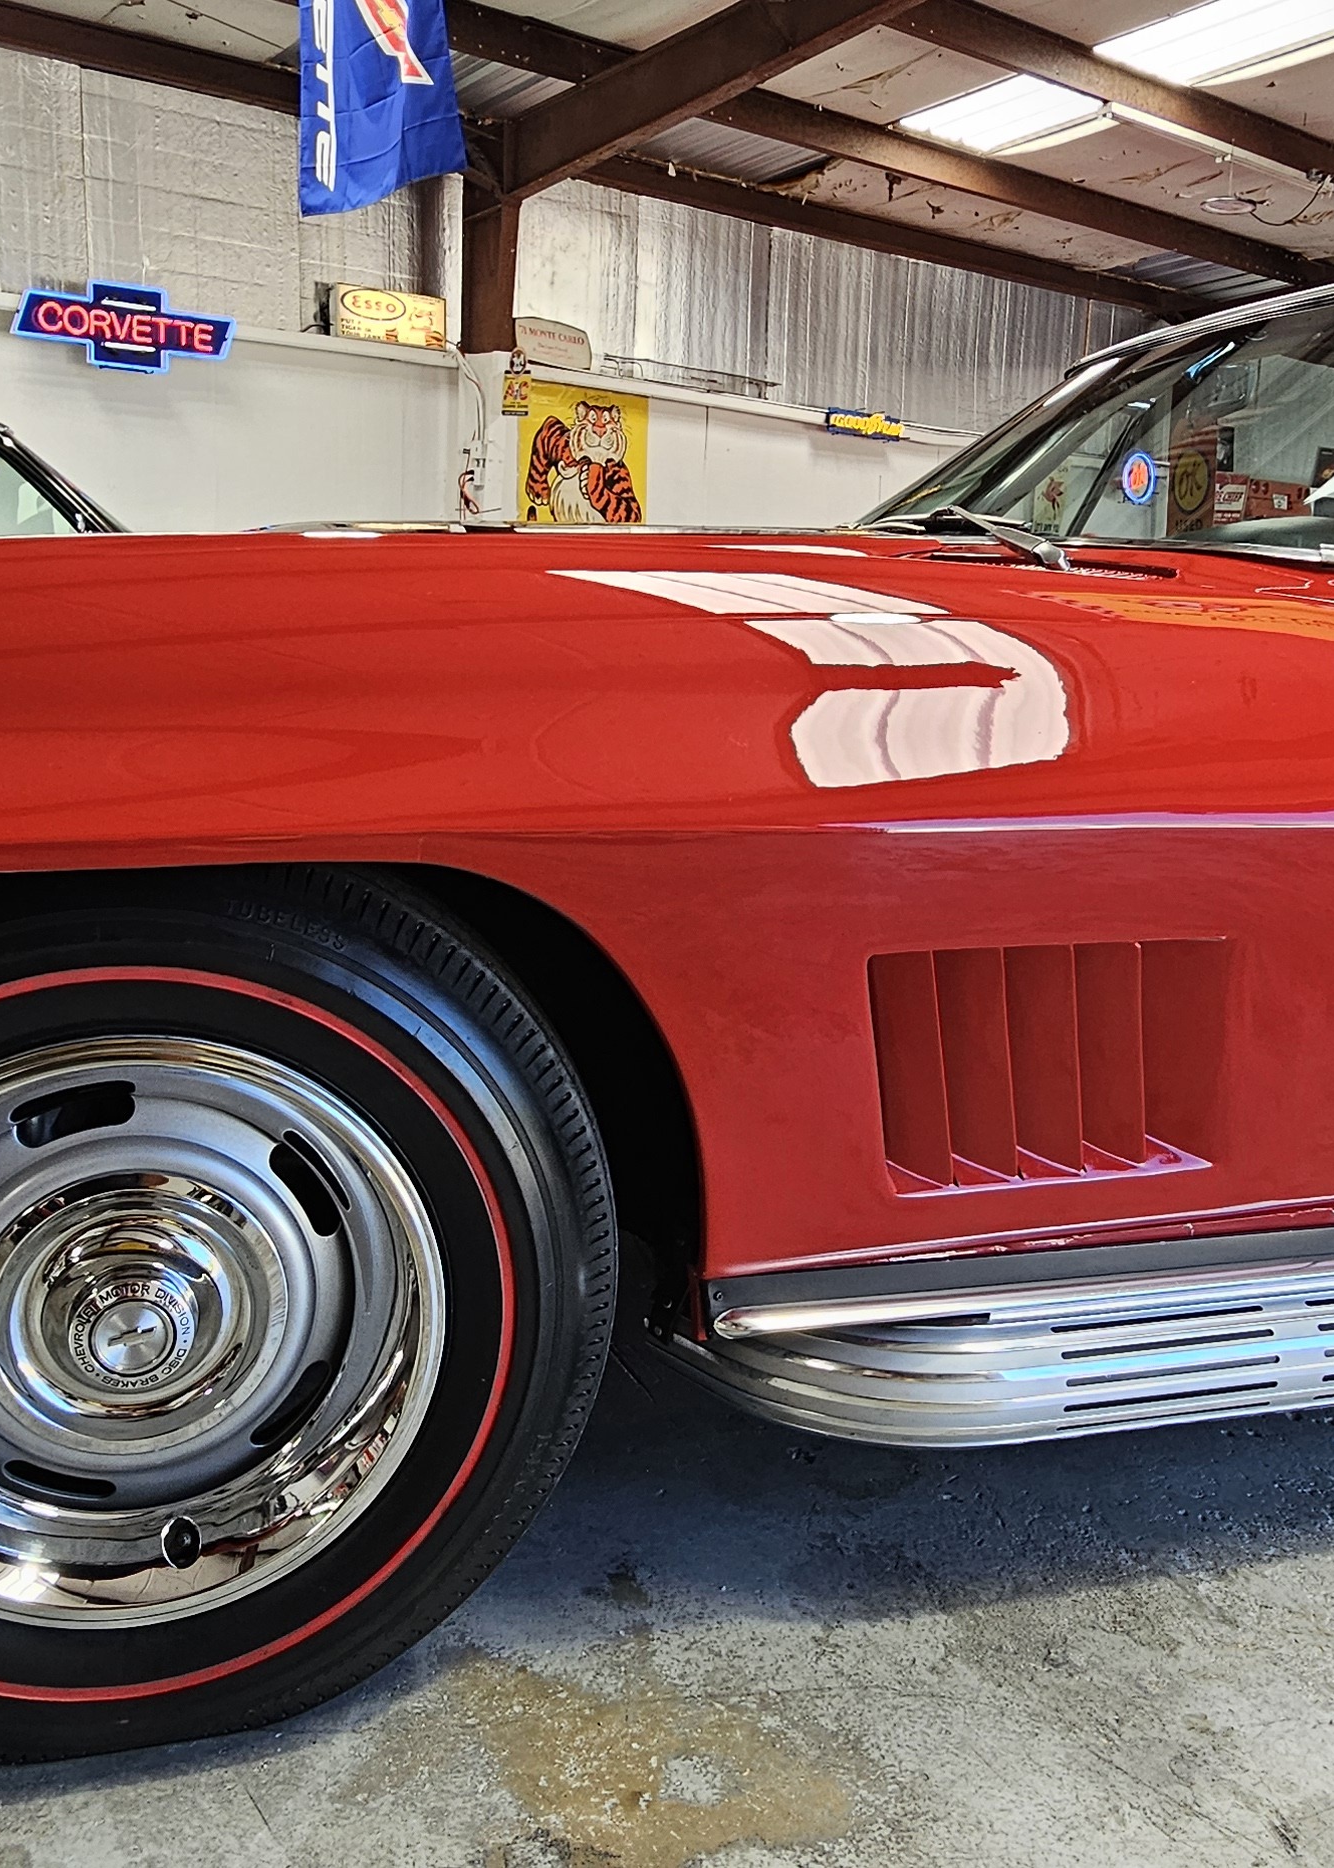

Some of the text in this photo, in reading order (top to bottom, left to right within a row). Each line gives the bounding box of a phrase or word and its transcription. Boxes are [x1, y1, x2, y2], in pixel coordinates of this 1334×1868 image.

[36, 301, 213, 352] CORVETTE
[352, 294, 396, 313] ESSO
[529, 327, 556, 340] MONTE
[226, 899, 347, 952] TUBELESS
[74, 1282, 191, 1373] CHEVROLET MOTOR DIVISION
[101, 1348, 188, 1389] DISC BRAKES
